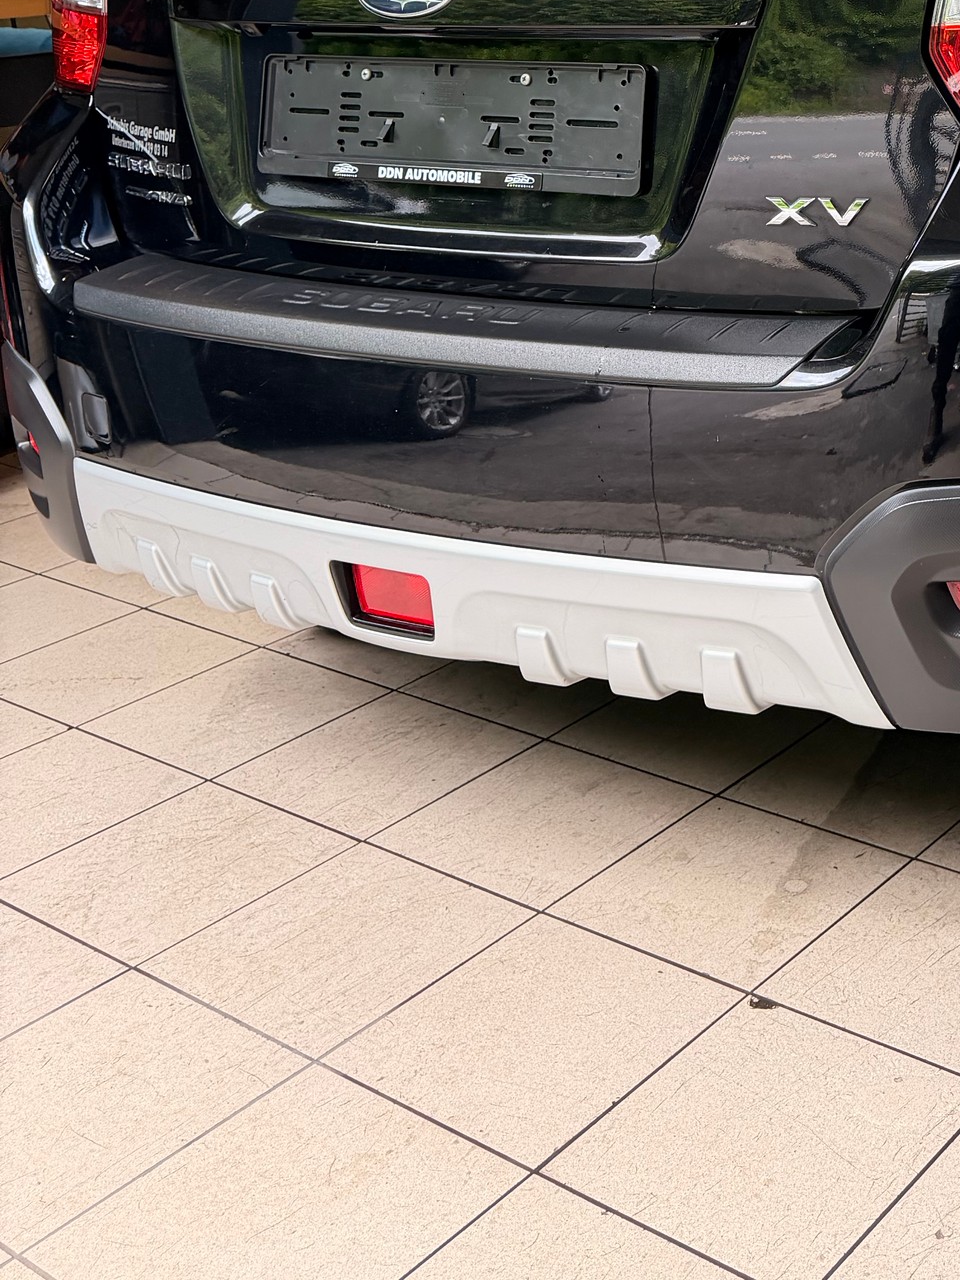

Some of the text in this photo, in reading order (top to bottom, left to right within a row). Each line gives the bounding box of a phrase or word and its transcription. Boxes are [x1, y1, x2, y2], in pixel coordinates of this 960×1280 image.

[129, 121, 152, 141] Garage
[153, 126, 176, 143] GmbH
[377, 166, 482, 184] DDN AUTOMOBILE
[765, 196, 870, 227] XV
[283, 289, 544, 325] SUBARU
